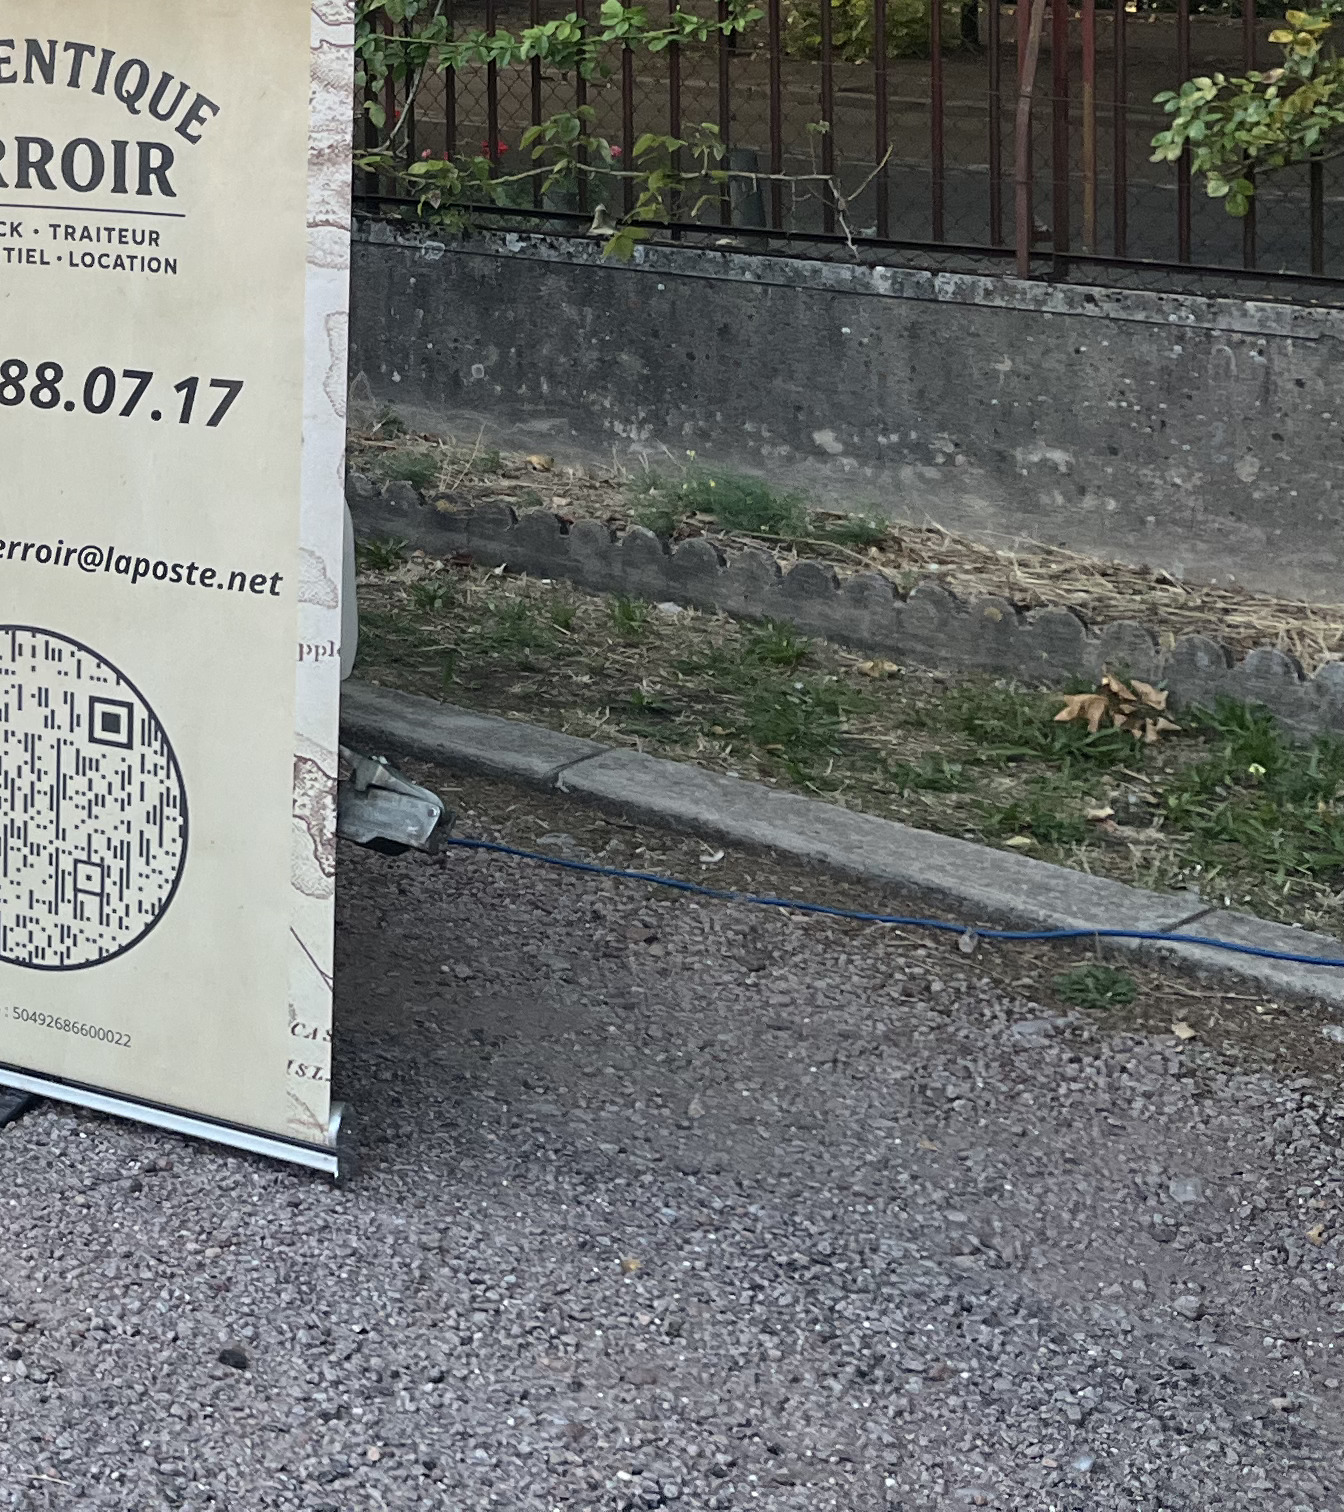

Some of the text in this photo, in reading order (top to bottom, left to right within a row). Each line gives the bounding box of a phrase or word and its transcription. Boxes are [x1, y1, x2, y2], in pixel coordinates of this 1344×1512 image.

[48, 223, 160, 248] TRAITEUR
[69, 251, 178, 275] LOCATION
[12, 1006, 132, 1048] 50492686600022
